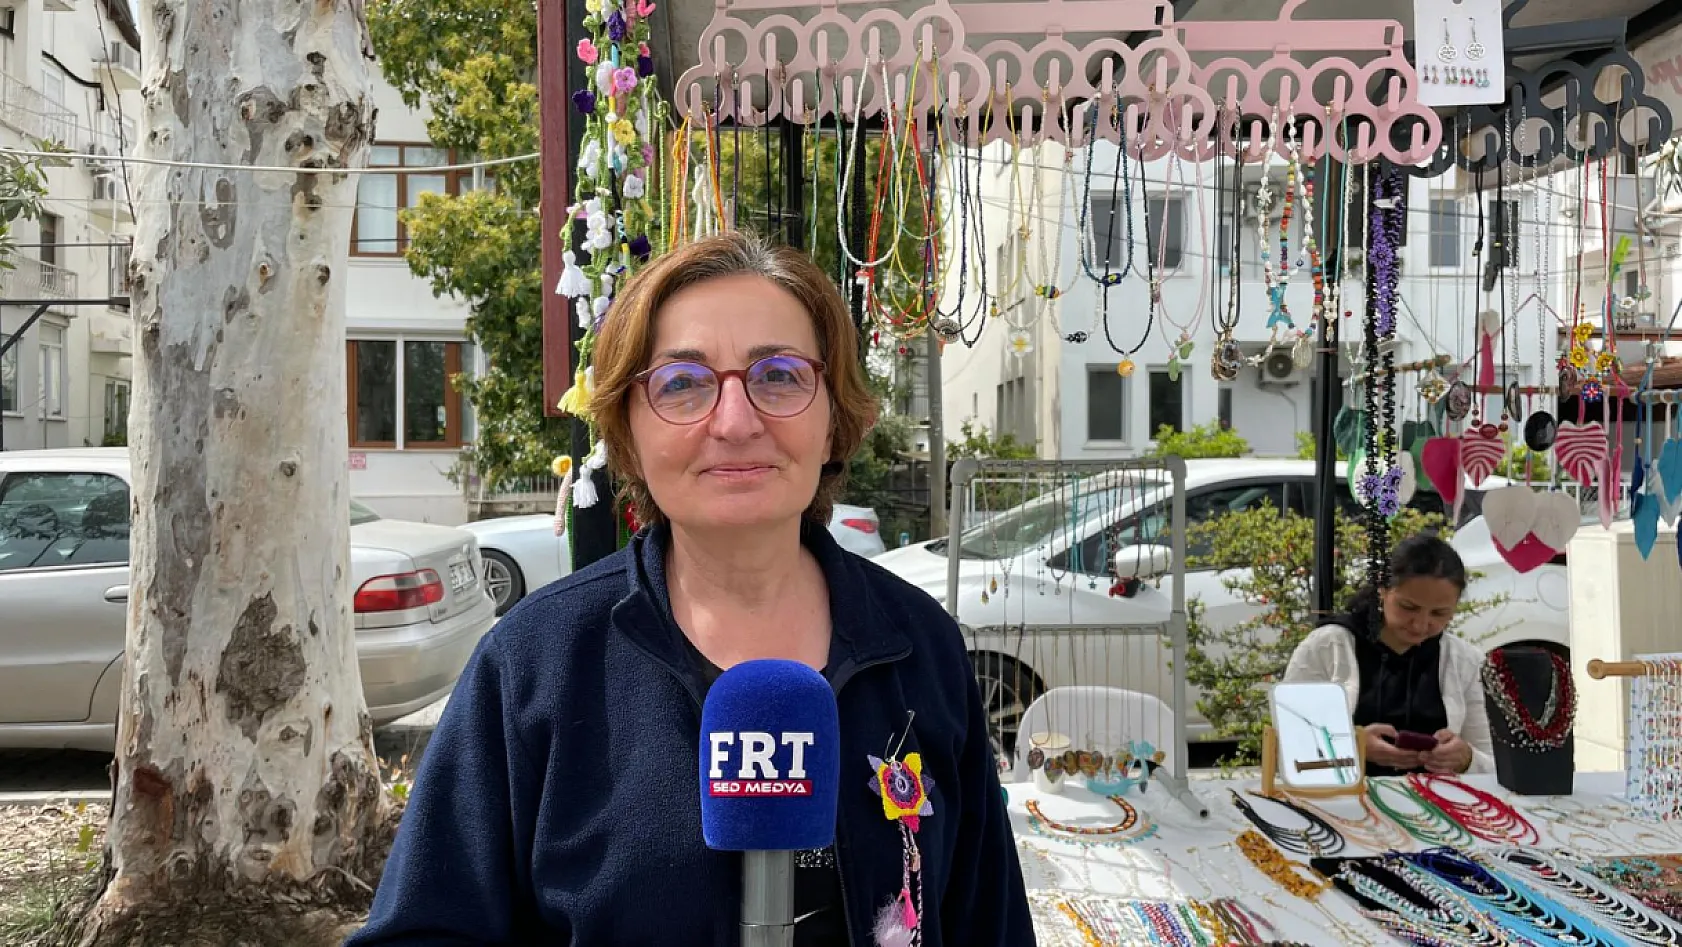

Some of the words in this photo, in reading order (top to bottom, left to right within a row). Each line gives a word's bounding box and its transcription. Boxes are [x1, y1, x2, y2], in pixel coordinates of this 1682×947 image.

[709, 732, 815, 779] FRT
[712, 782, 740, 793] SED
[744, 782, 807, 793] MEDYA
